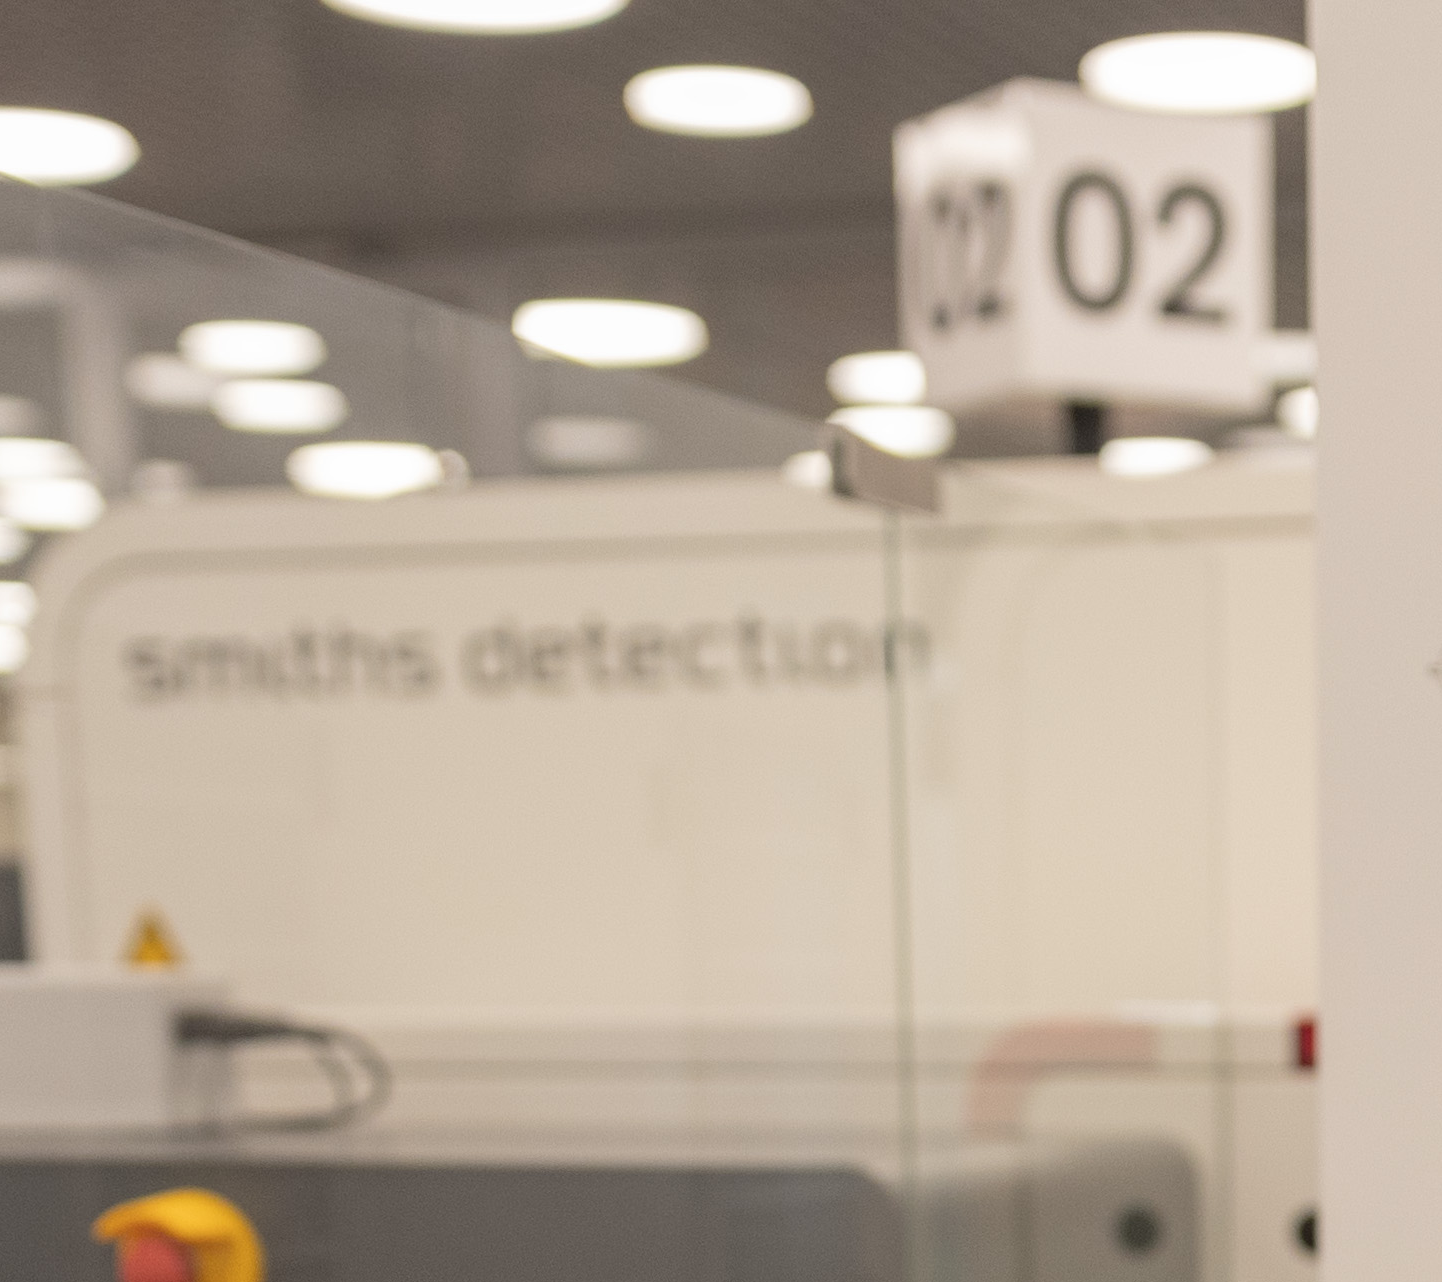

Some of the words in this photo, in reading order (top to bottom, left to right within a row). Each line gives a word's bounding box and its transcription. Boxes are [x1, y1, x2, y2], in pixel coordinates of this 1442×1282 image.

[1054, 167, 1228, 326] 02
[120, 622, 442, 704] smiths
[458, 612, 936, 700] detection
